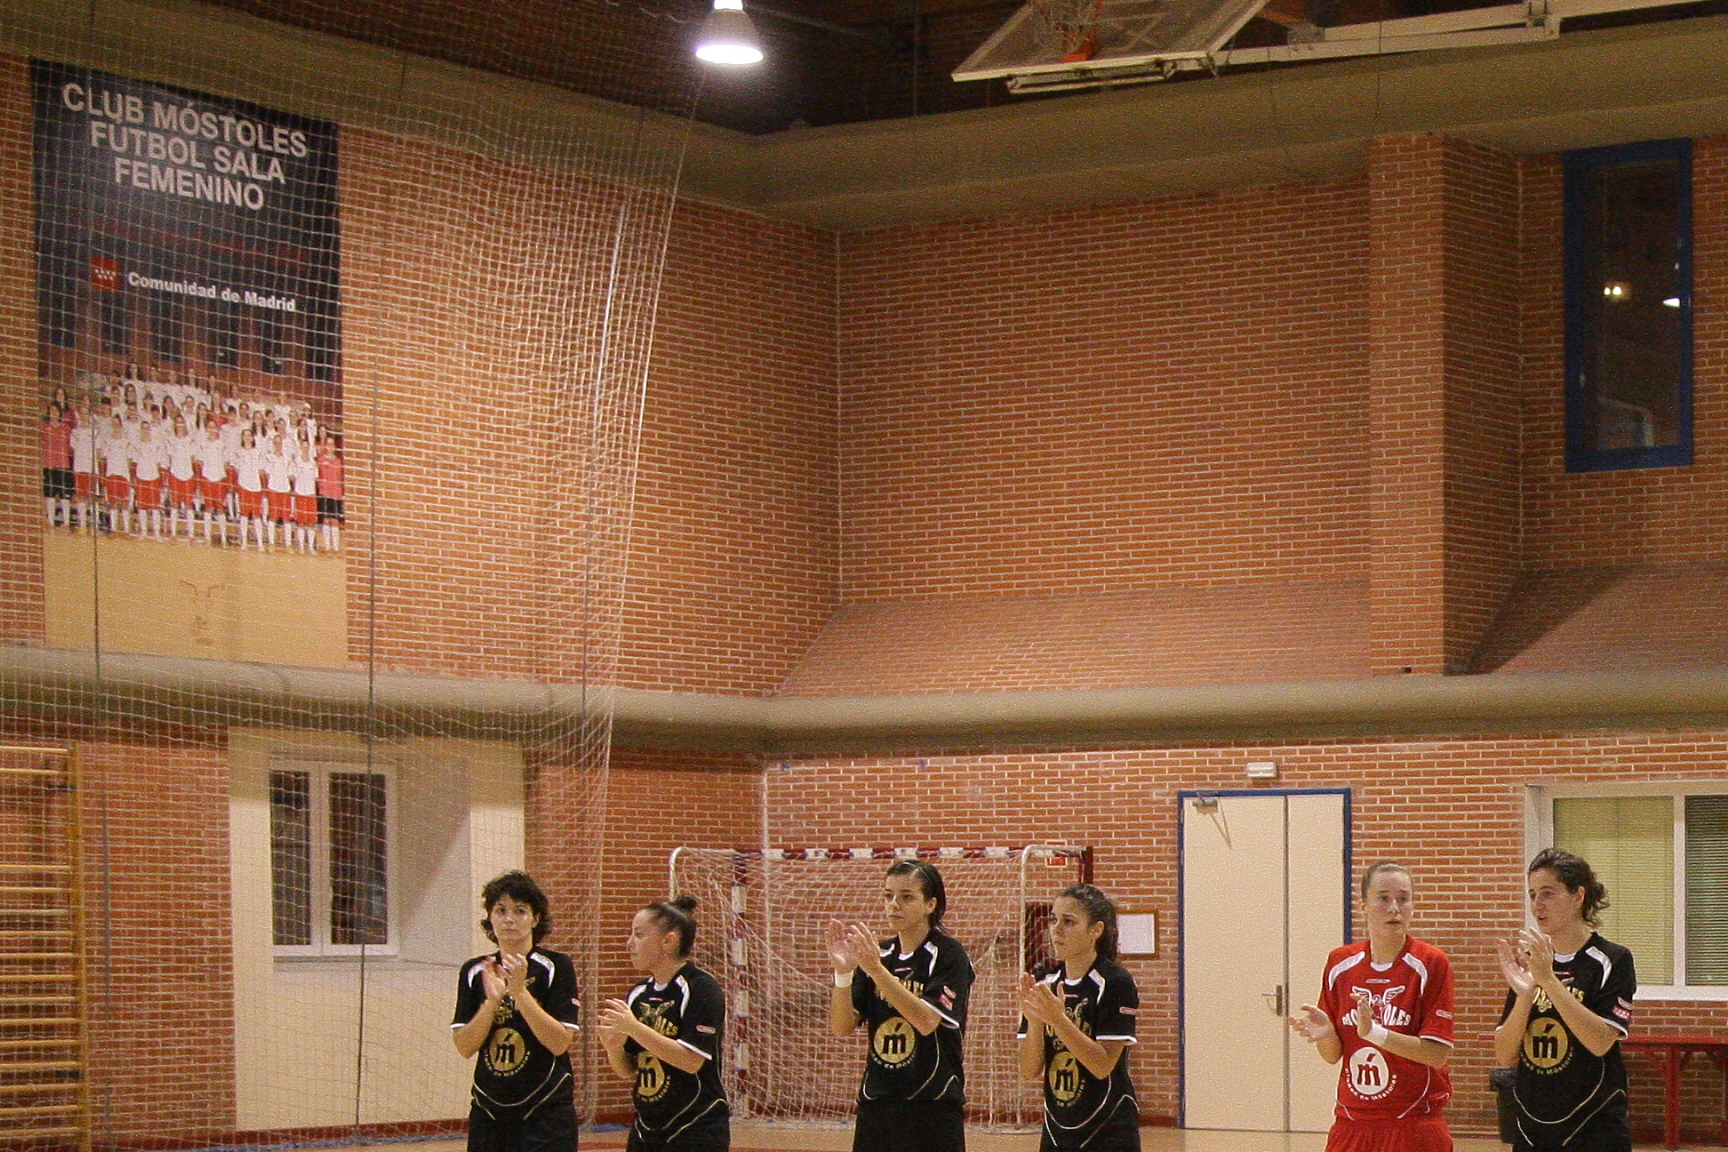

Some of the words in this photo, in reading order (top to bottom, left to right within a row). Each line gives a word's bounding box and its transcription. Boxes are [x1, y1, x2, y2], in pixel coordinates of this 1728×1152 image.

[63, 82, 145, 125] CLUB
[91, 120, 207, 170] FUTBOL
[213, 145, 287, 185] SALA
[115, 156, 264, 210] FEMENINO
[128, 271, 216, 299] Comunidad
[220, 287, 240, 304] de
[244, 290, 296, 313] Madrid
